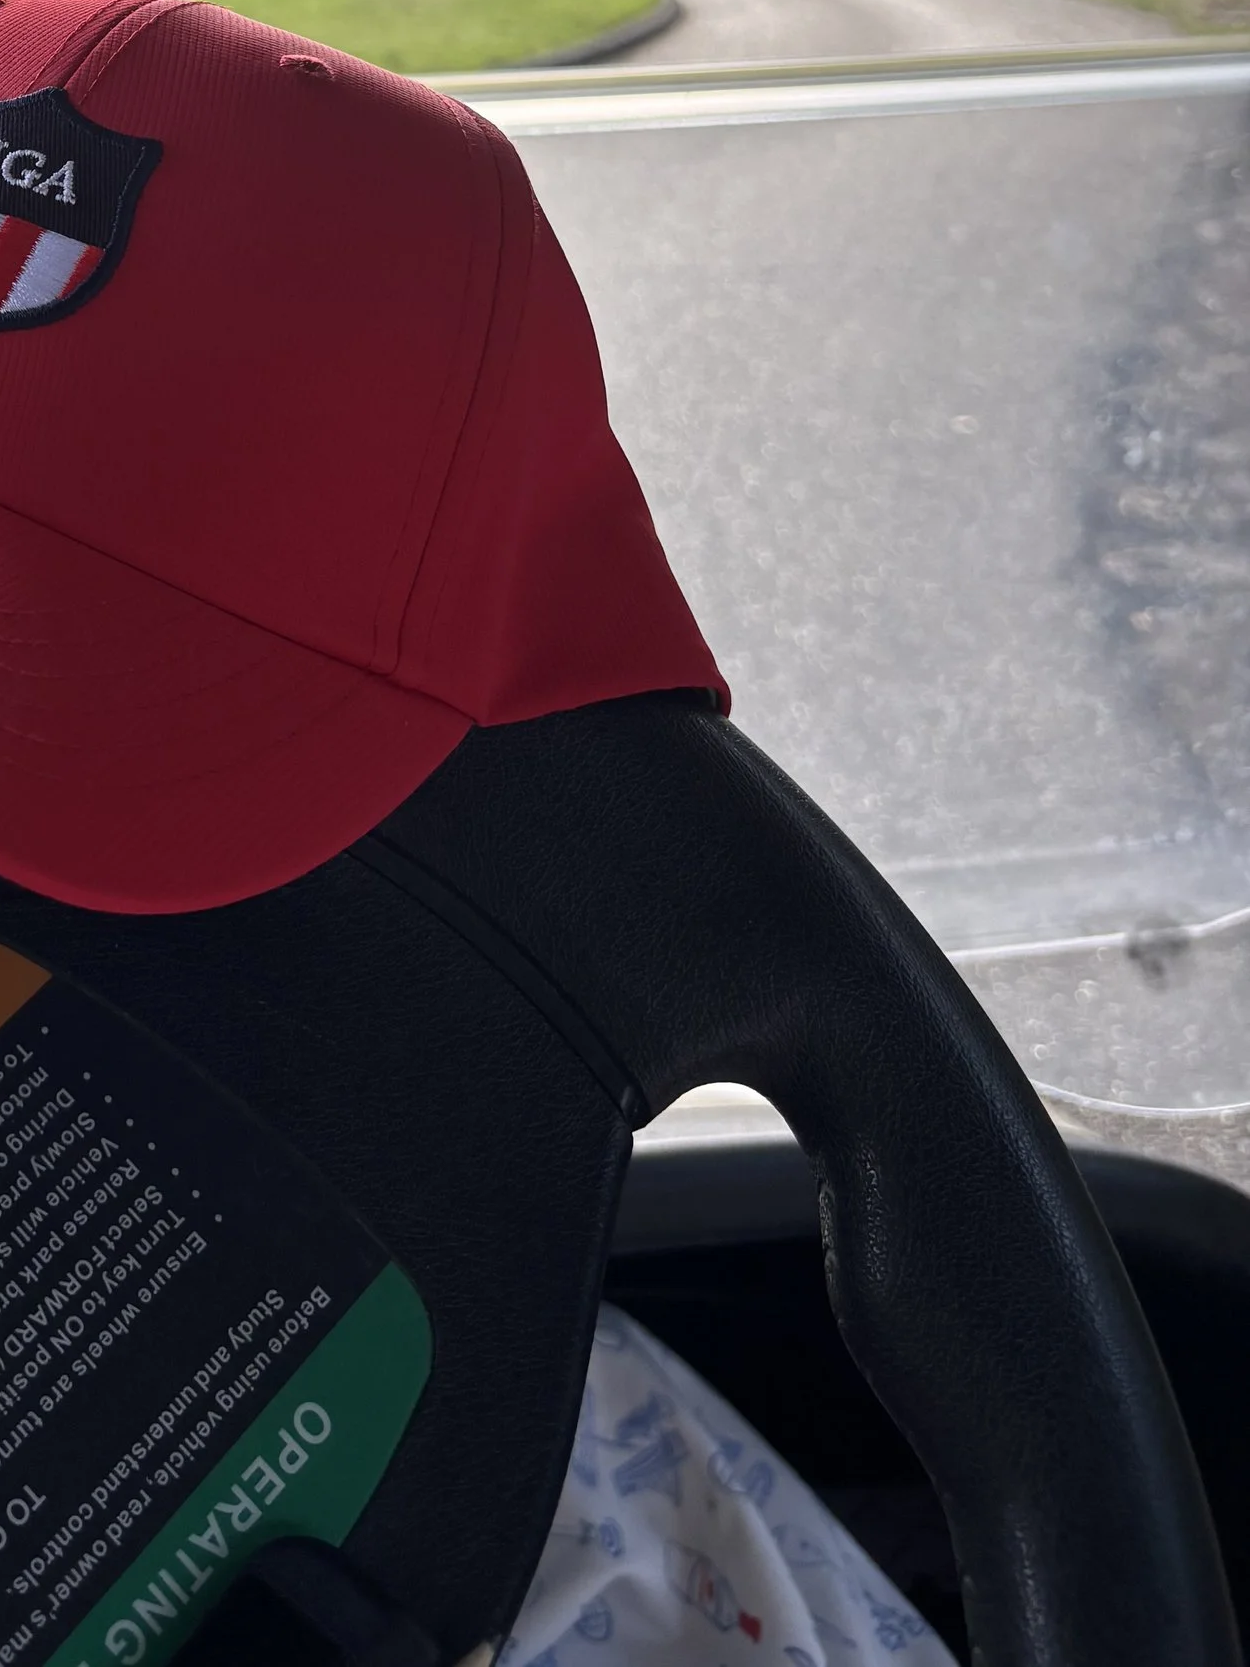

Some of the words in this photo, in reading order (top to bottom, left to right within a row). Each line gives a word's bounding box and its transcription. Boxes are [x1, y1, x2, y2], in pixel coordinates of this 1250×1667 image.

[3, 1043, 34, 1069] To
[5, 1087, 76, 1155] During
[30, 1111, 96, 1179] Slowly
[45, 1137, 120, 1207] Vehicle
[62, 1157, 141, 1237] Release
[10, 1206, 49, 1249] will
[99, 1185, 163, 1251] Select
[134, 1208, 186, 1256] Turn
[17, 1230, 65, 1284] park
[101, 1252, 142, 1295] key
[137, 1230, 208, 1304] Ensure
[3, 1245, 108, 1358] FORWARD
[81, 1290, 107, 1315] to
[227, 1289, 285, 1351] Study
[267, 1285, 332, 1354] Before
[49, 1315, 85, 1355] ON
[71, 1302, 141, 1377] wheels
[39, 1374, 74, 1412] are
[193, 1345, 231, 1393] and
[214, 1351, 272, 1413] using
[90, 1385, 198, 1510] understand
[145, 1410, 223, 1486] vehicle,
[5, 1484, 47, 1527] TO
[104, 1401, 332, 1666] OPERATING
[105, 1488, 152, 1547] read
[5, 1502, 94, 1595] controls.
